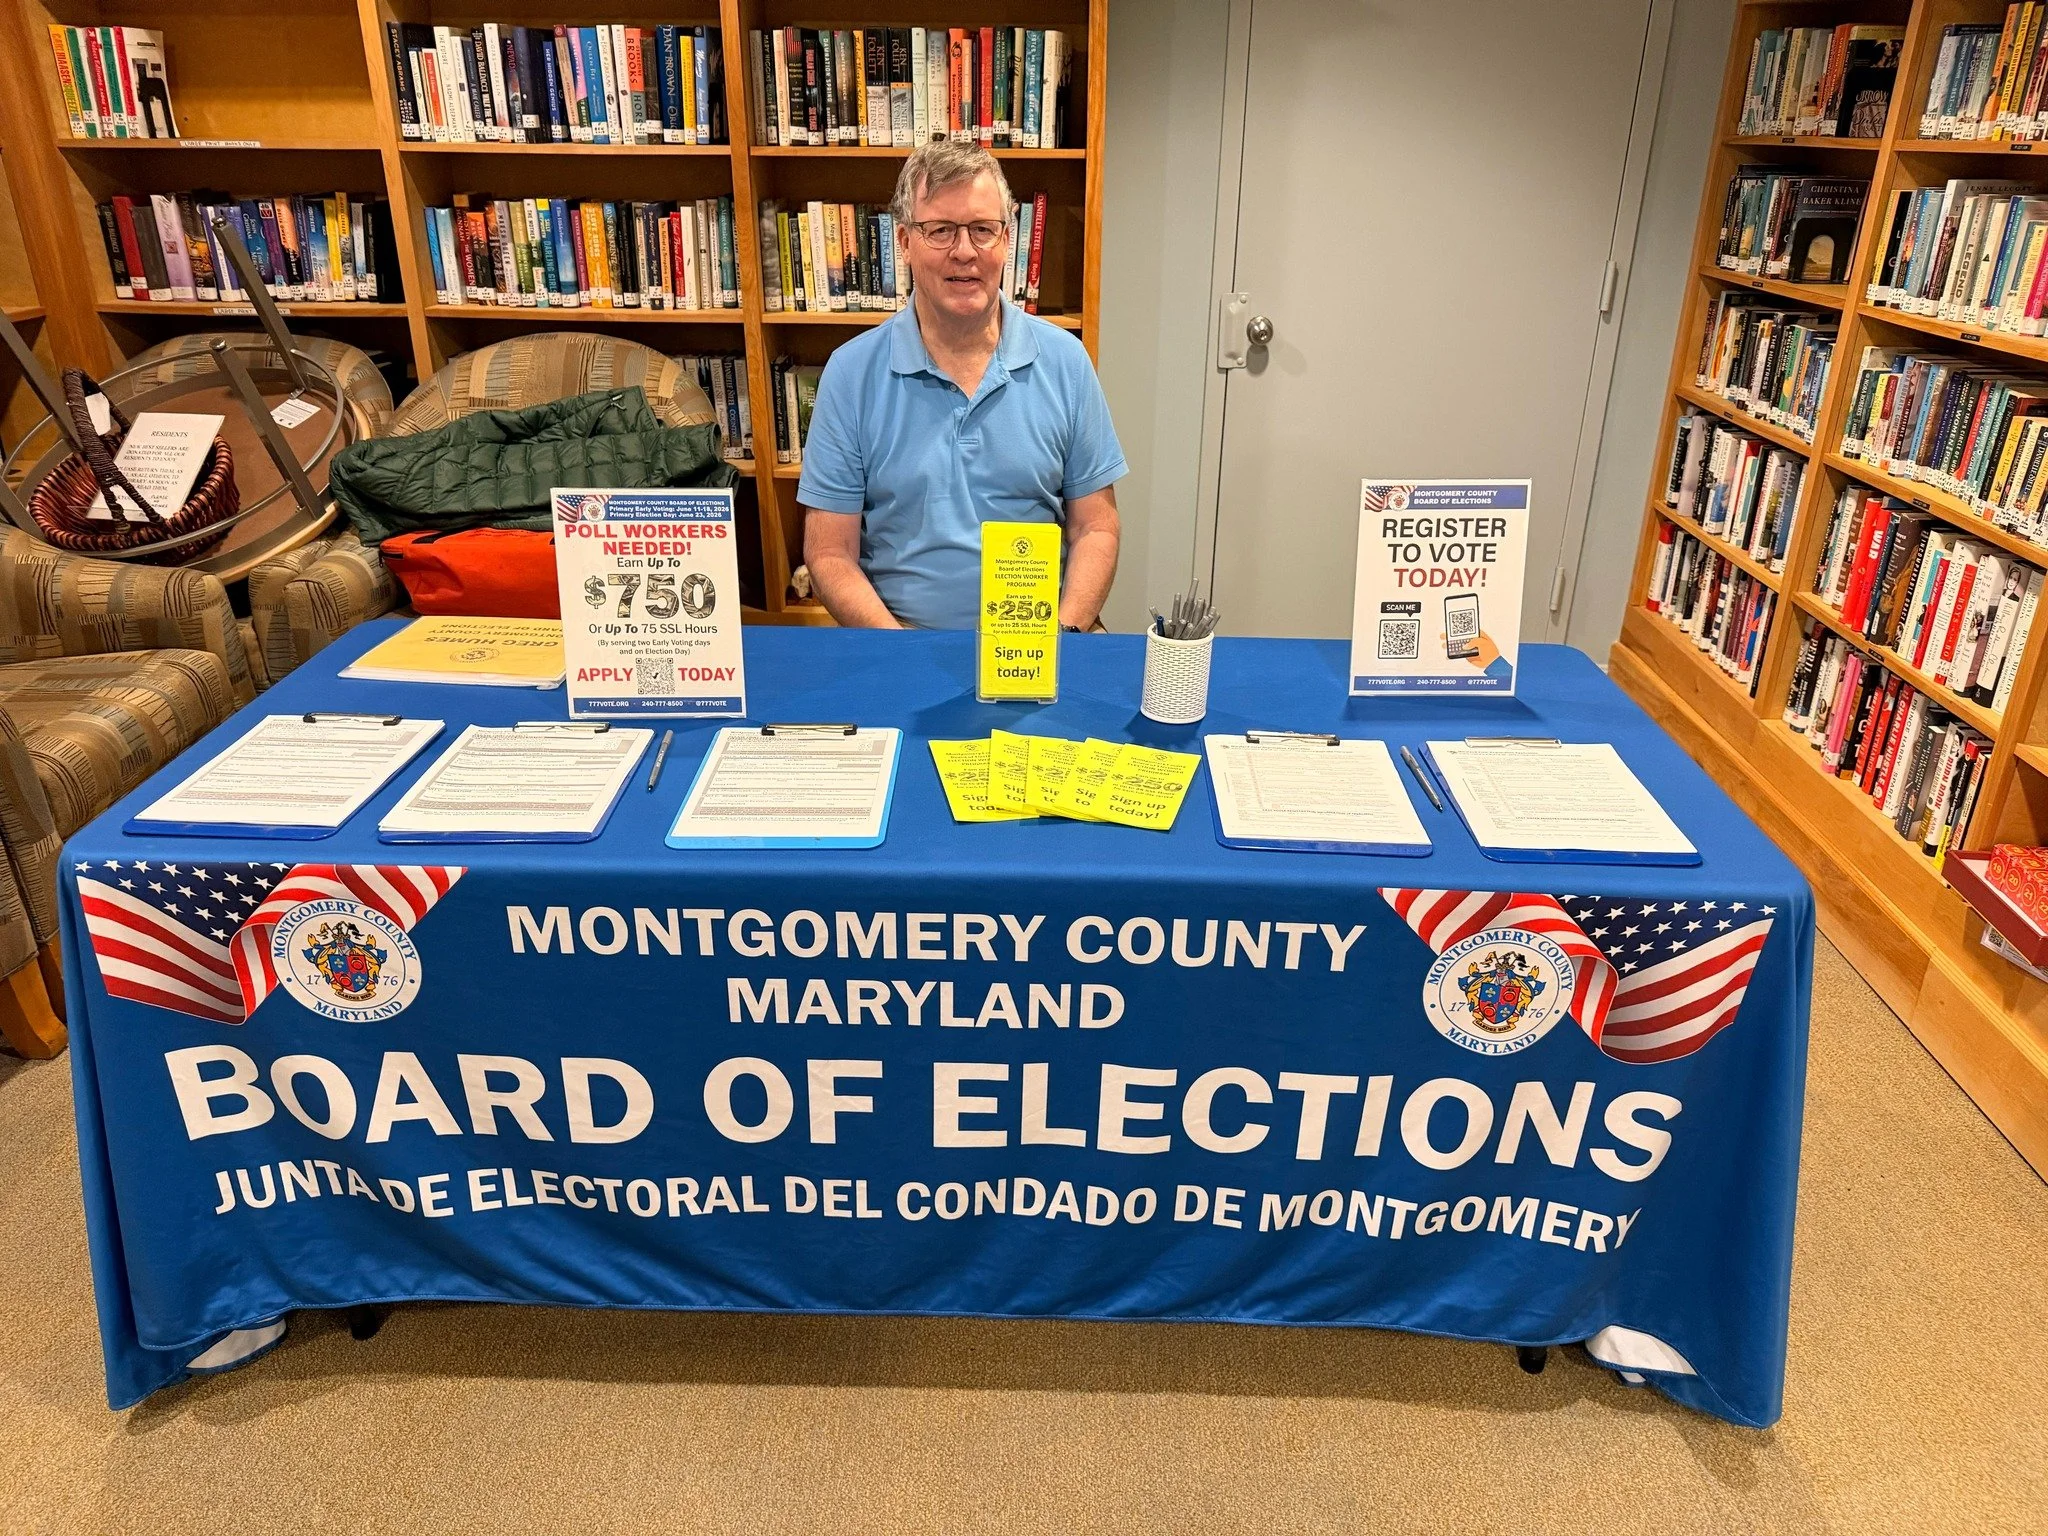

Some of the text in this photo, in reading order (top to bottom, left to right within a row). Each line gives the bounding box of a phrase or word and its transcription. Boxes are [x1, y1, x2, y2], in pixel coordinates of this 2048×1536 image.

[391, 28, 406, 92] STACEY ABRAMS
[627, 38, 638, 84] BROOKS
[663, 26, 675, 96] DAN BROWN
[868, 36, 876, 76] FOLLETT
[892, 39, 900, 74] FOLLETT
[899, 47, 907, 66] KEN
[1810, 185, 1860, 194] CHRISTINA
[1802, 197, 1862, 206] BAKER KLINE
[1030, 195, 1044, 280] DANIELLE STEEL Royal
[465, 254, 476, 286] WOMEN
[1955, 244, 1974, 298] LEGEND
[1762, 349, 1775, 390] HUNTRESS
[1856, 378, 1870, 416] NORA ROBERTS
[565, 524, 727, 538] POLL WORKERS
[1382, 518, 1507, 538] REGISTER
[603, 542, 692, 555] NEEDED!
[1388, 543, 1497, 563] TO VOTE
[1869, 530, 1884, 559] WAR
[617, 558, 680, 569] Earn Up To
[1394, 568, 1487, 588] TODAY!
[584, 573, 716, 619] $750
[987, 600, 1052, 621] $250
[589, 624, 718, 635] Or Up To 75 SSL Hours
[652, 639, 669, 647] Early
[671, 639, 693, 647] Voting
[694, 639, 710, 647] days
[674, 648, 690, 656] Day)
[995, 646, 1043, 660] Sign up
[1804, 638, 1819, 672] PERIL
[577, 668, 735, 682] APPLY TODAY
[997, 667, 1040, 680] today!
[1879, 700, 1906, 789] CHARLIE HUSTLE
[1886, 699, 1918, 805] PRINCE HARRY SPARE
[1112, 774, 1183, 792] $250
[1110, 795, 1141, 806] Sign
[1109, 805, 1159, 819] today!
[1992, 862, 2002, 874] 19
[2009, 875, 2018, 887] 20
[2024, 888, 2033, 901] 21
[2039, 901, 2048, 914] 22
[273, 901, 418, 961] MONTGOMERY COUNTY
[506, 905, 1368, 973] MONTGOMERY COUNTY
[1426, 930, 1574, 991] MONTGOMERY COUNTY
[307, 975, 398, 986] 17 76
[313, 999, 403, 1022] MARYLAND
[726, 977, 1125, 1029] MARYLAND
[1449, 1001, 1544, 1019] 17 76
[1445, 1026, 1538, 1055] MARYLAND
[164, 1044, 1683, 1183] BOARD OF ELECTIONS
[213, 1159, 1642, 1254] JUNTA DE ELECTORAL DEL CONDADO DE MONTGOMERY
